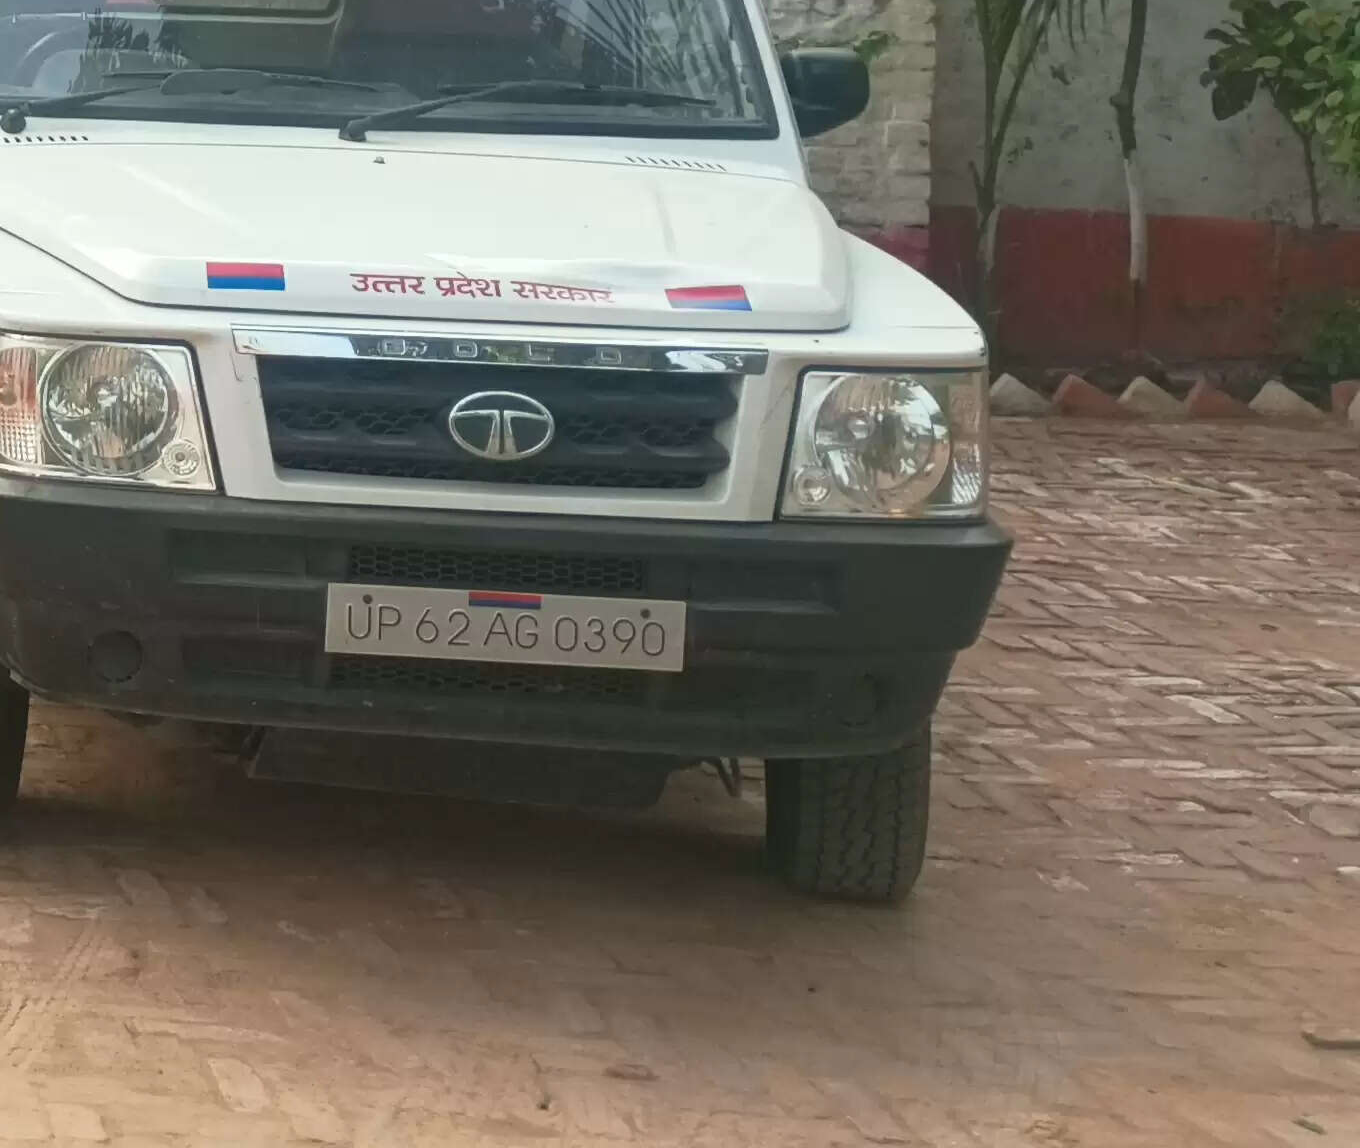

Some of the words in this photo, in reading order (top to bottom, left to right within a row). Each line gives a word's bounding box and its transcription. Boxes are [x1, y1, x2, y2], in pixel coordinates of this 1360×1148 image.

[350, 273, 425, 294] उत्तर
[434, 272, 502, 298] प्रदेश
[510, 281, 616, 304] सरकार
[346, 604, 402, 641] UP
[415, 608, 471, 647] 62
[483, 611, 539, 650] AG
[554, 615, 666, 657] 0390
